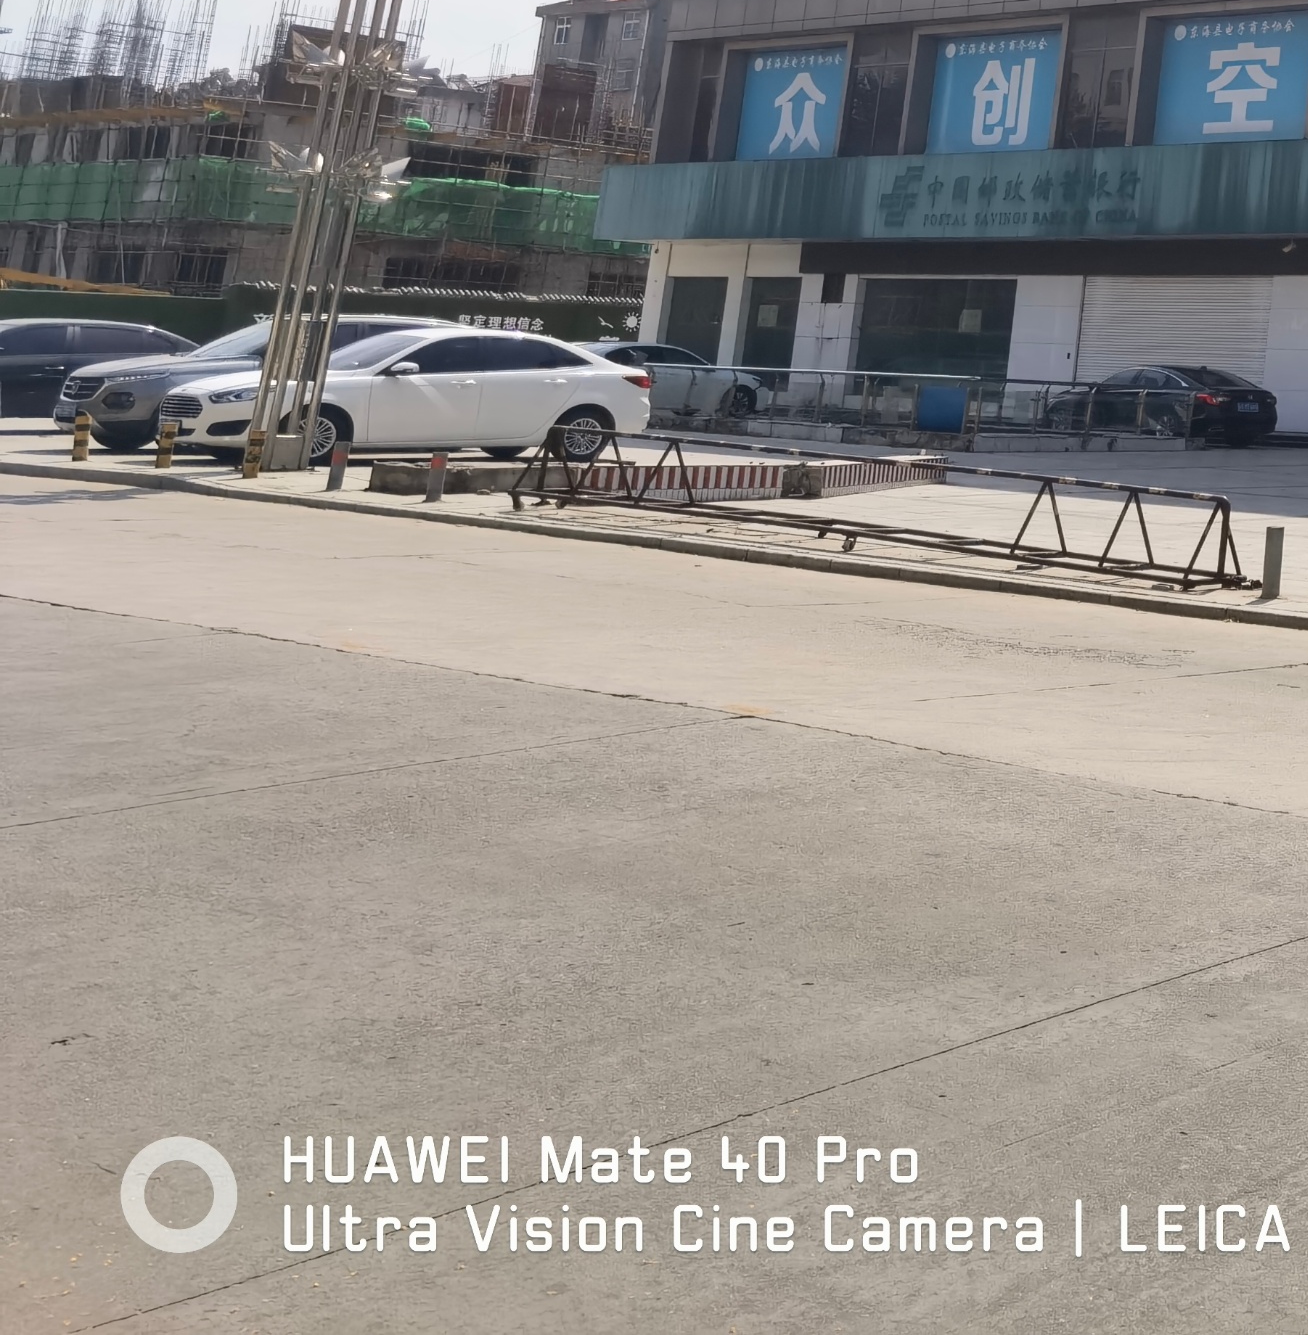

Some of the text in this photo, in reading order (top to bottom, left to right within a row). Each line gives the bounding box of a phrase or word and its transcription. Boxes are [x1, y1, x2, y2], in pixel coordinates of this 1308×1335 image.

[459, 313, 545, 331] 坚定理想信念
